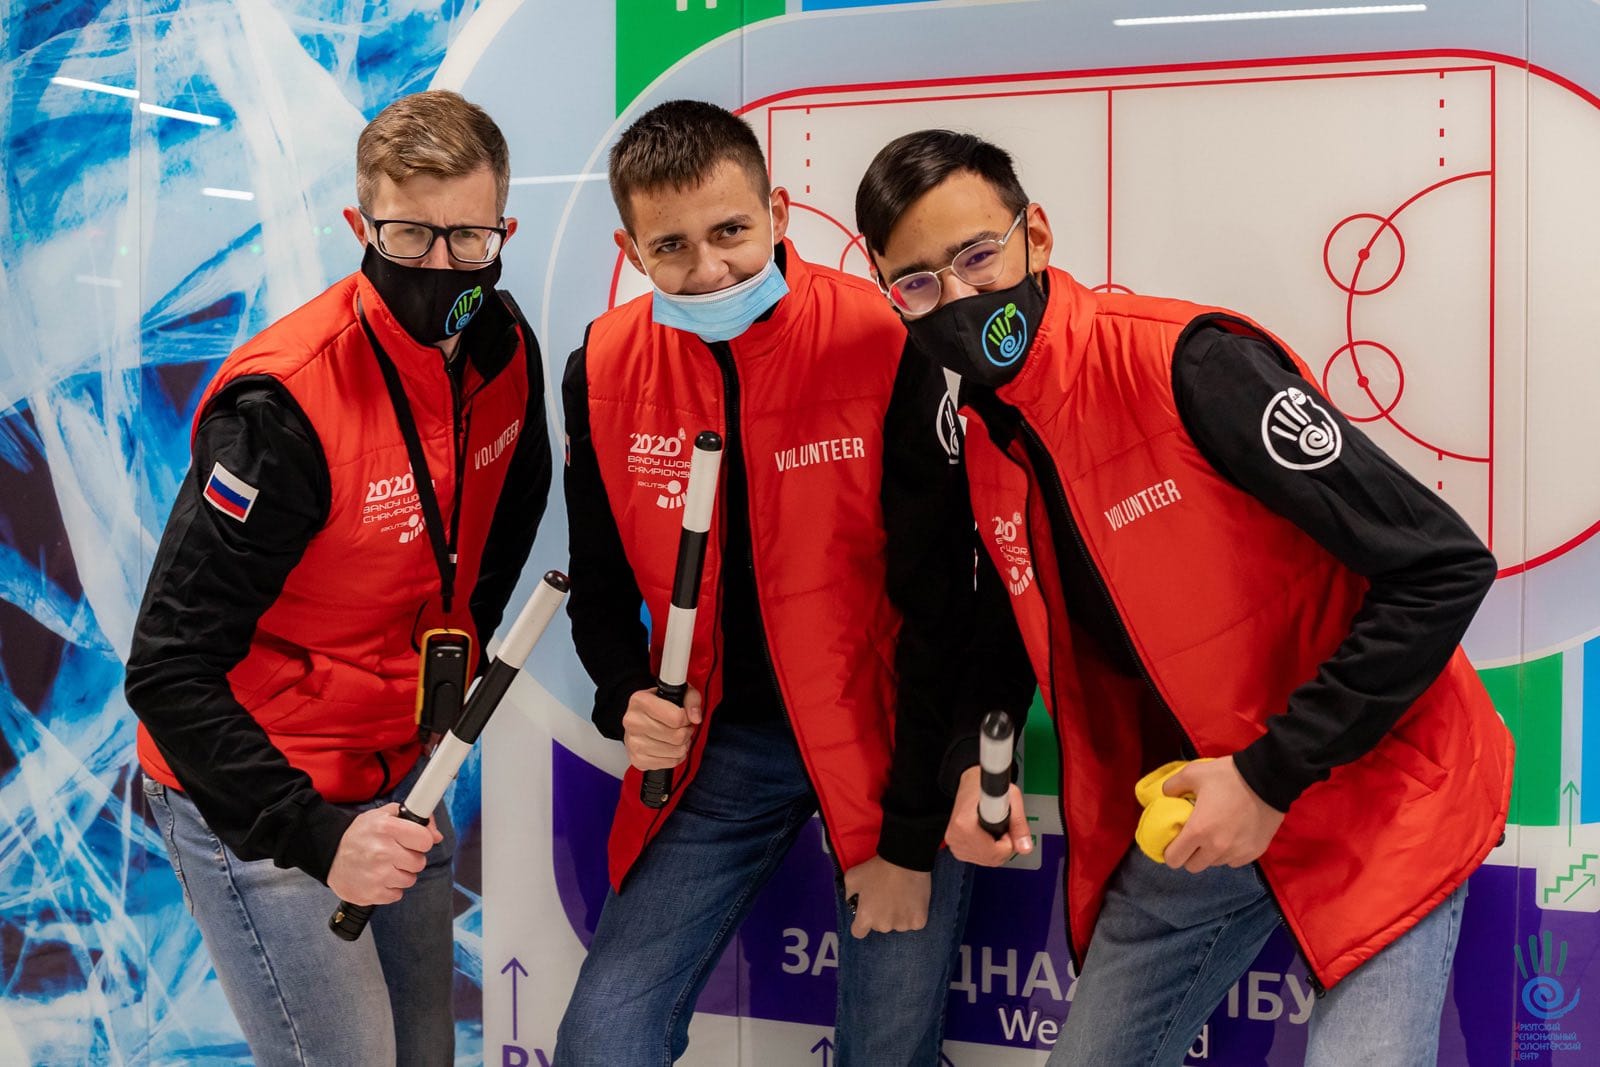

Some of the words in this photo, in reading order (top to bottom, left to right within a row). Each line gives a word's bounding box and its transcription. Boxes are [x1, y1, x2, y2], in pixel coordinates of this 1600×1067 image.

[474, 419, 520, 470] VOLUNTEER
[774, 437, 865, 472] VOLUNTEER
[627, 455, 660, 466] BANDY
[663, 459, 691, 468] WOR
[362, 501, 422, 524] CHAMPIONS
[363, 498, 401, 514] BANDY
[402, 493, 420, 505] WO
[1103, 478, 1182, 532] VOLUNTEER
[1005, 544, 1029, 556] WOR
